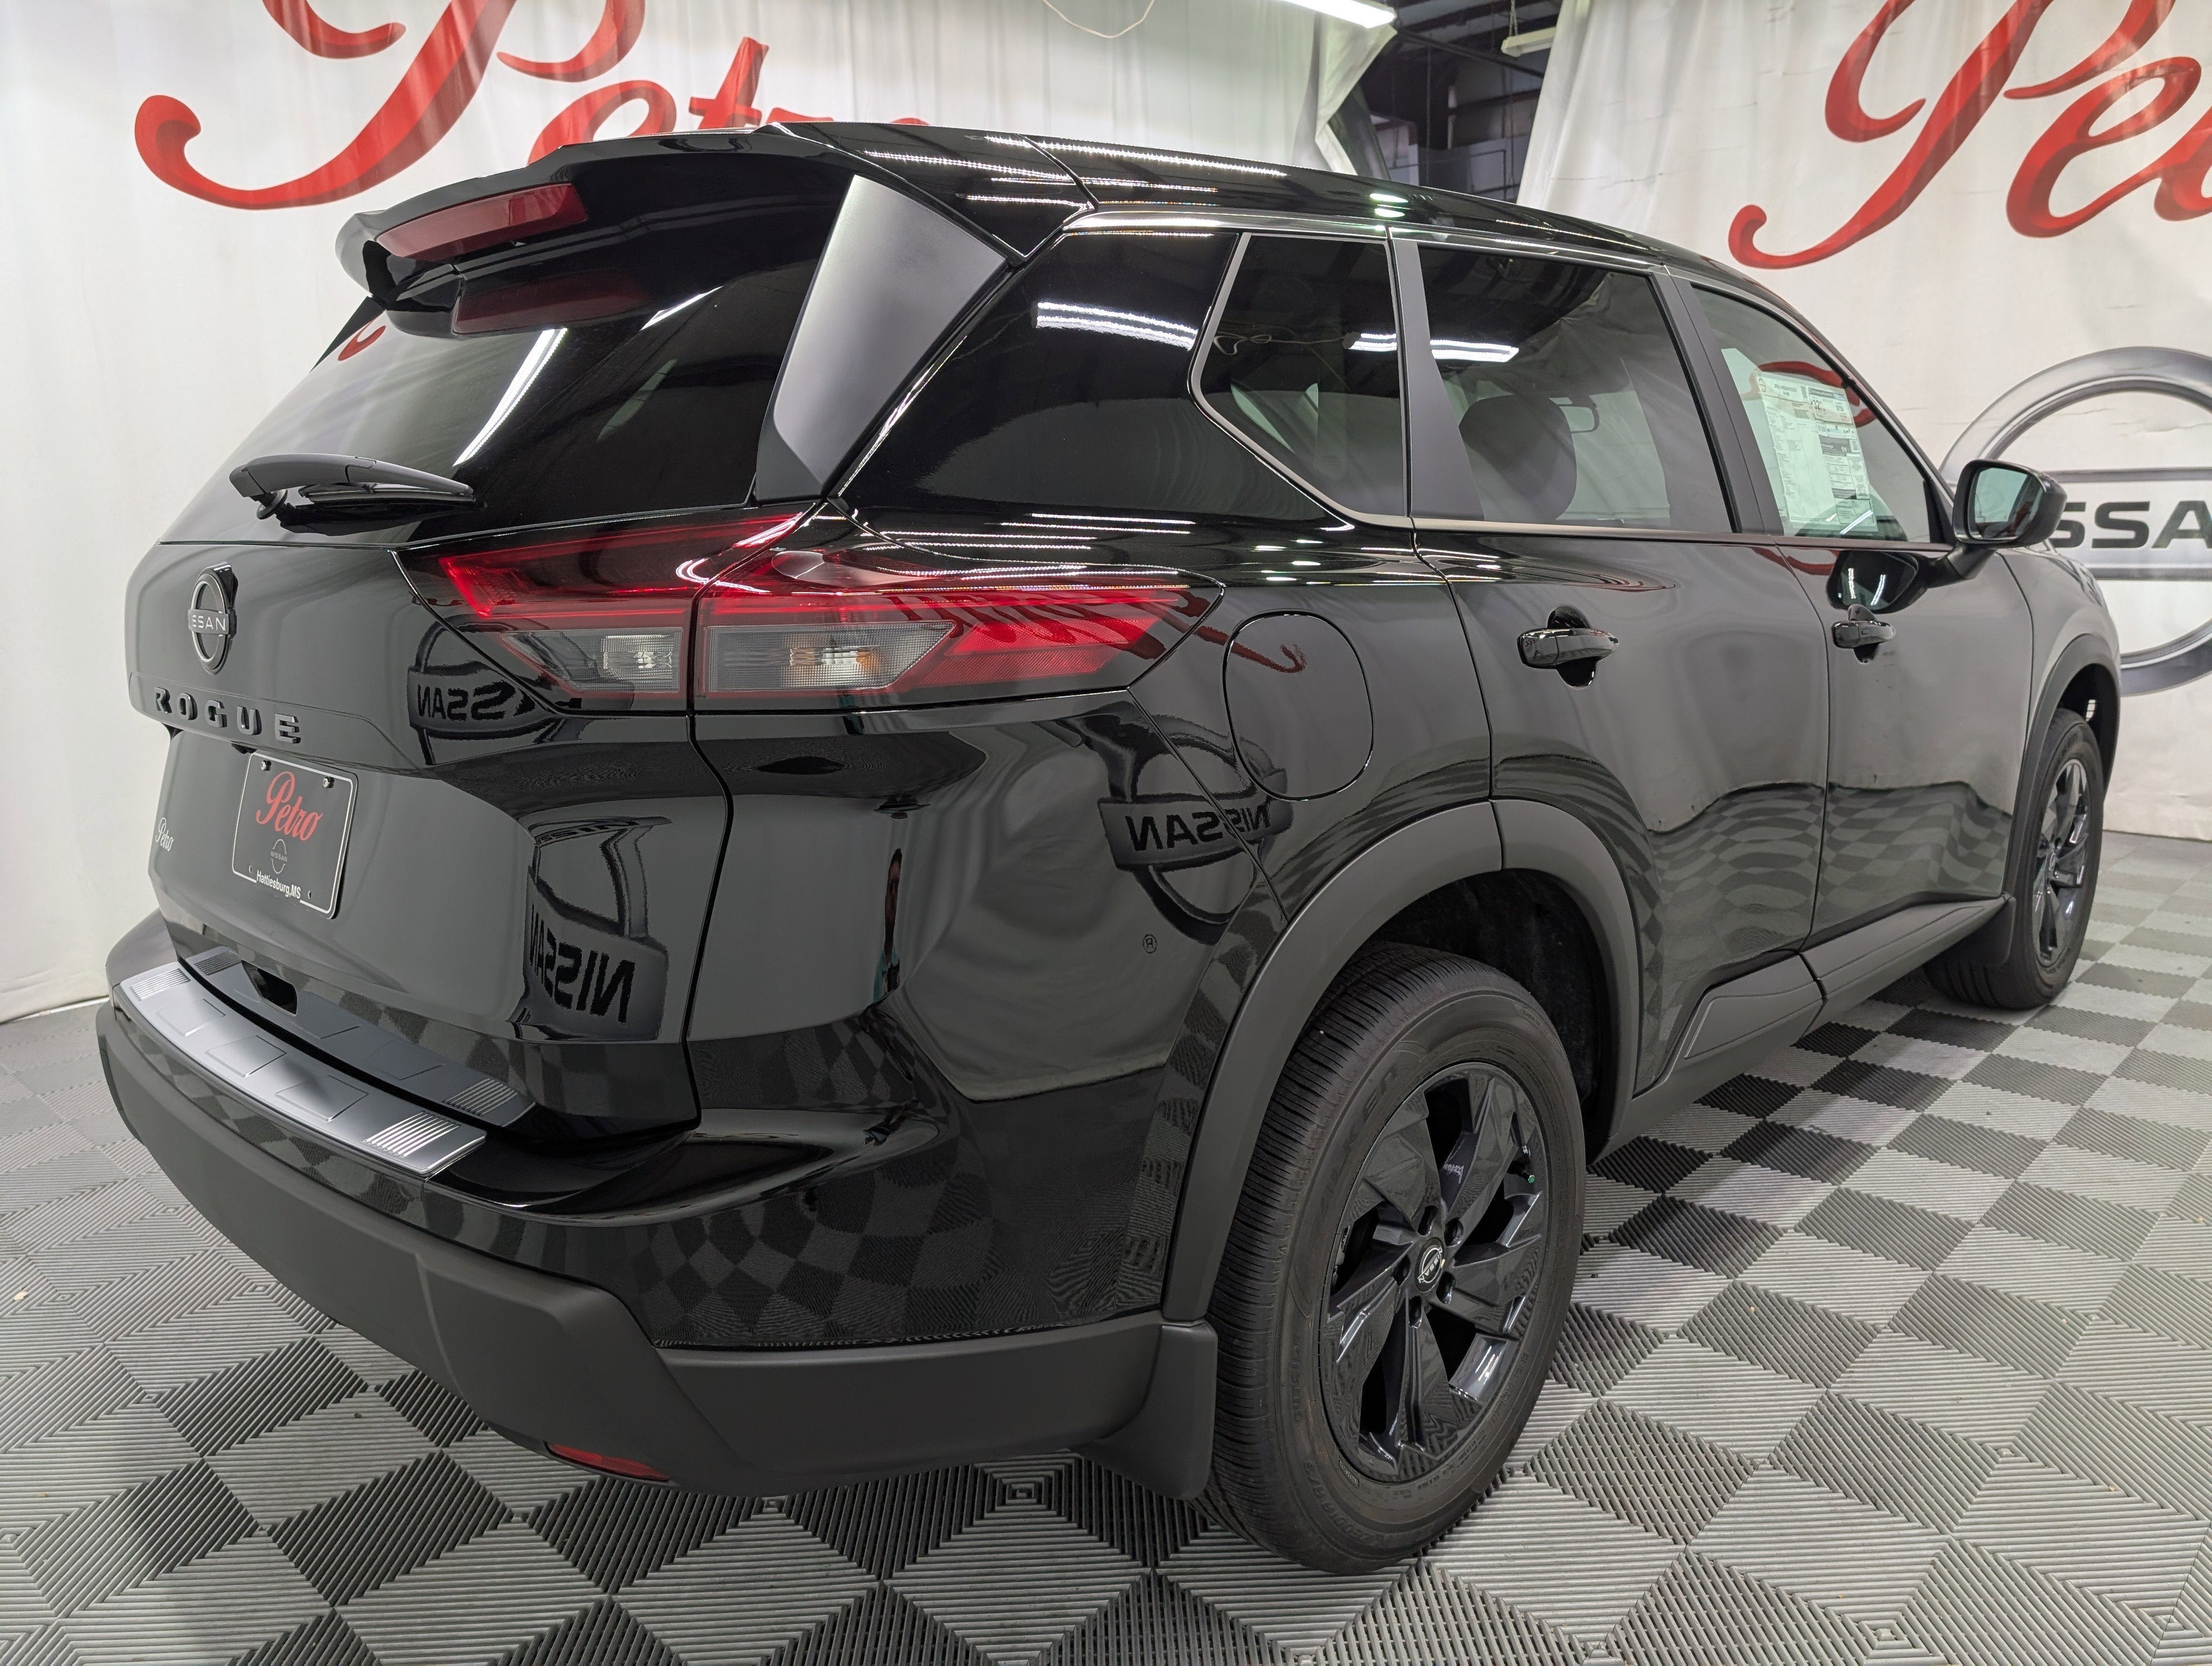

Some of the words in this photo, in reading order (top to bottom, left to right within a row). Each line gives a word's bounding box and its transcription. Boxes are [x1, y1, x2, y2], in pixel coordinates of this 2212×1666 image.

[2052, 500, 2212, 549] SSA
[189, 614, 226, 632] SSAN
[153, 687, 302, 745] ROGUE
[255, 771, 323, 841] Petro
[155, 817, 175, 851] Petro
[270, 851, 287, 862] NISSAN
[1418, 1246, 1443, 1284] NISSAN
